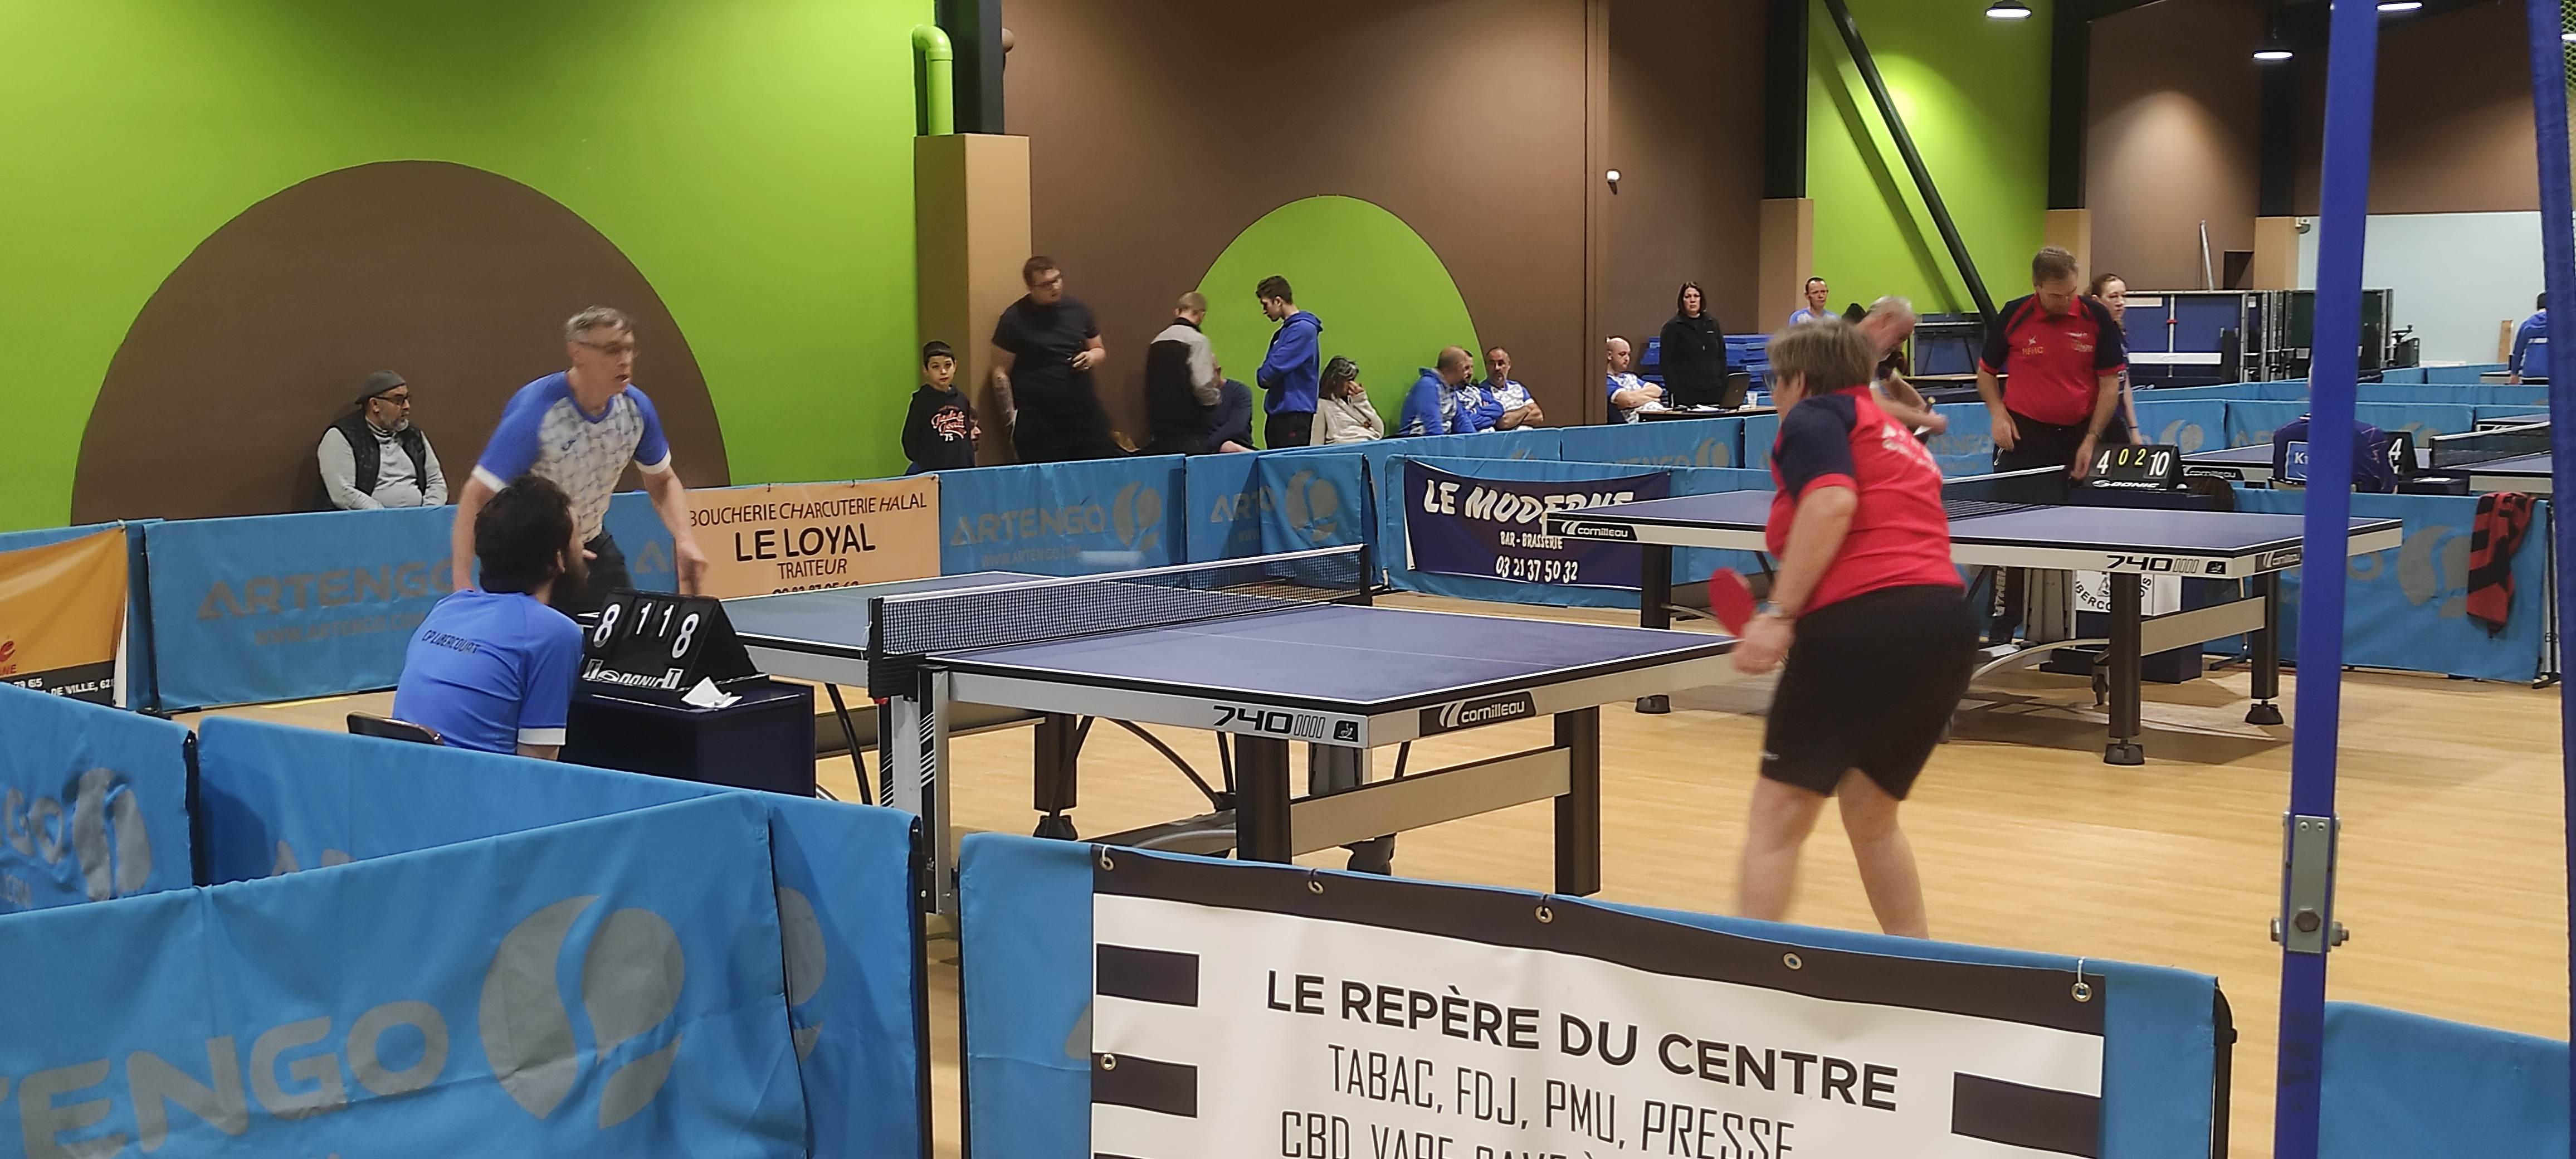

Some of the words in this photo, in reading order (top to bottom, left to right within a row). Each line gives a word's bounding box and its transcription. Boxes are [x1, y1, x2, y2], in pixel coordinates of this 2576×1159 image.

[2096, 450, 2111, 474] 4
[2119, 448, 2129, 465] 0
[2134, 448, 2146, 465] 2
[2150, 451, 2170, 476] 10
[690, 503, 777, 526] BOUCHERIE
[780, 496, 876, 519] CHARCUTERIE
[879, 492, 928, 512] HALAL
[1423, 479, 1460, 515] LE
[735, 529, 777, 562] LE
[783, 522, 876, 557] LOYAL
[950, 504, 1106, 546] ARTENGO
[1499, 531, 1515, 547] BAR
[1521, 533, 1563, 549] BRASSERIE
[1577, 525, 1628, 537] cornilleau
[777, 558, 847, 580] TRAITEUR
[1495, 556, 1510, 578] 03
[1513, 560, 1525, 576] 21
[1527, 560, 1541, 581] 37
[1544, 561, 1560, 583] 50
[1562, 562, 1578, 583] 32
[2106, 554, 2173, 572] 740
[198, 558, 453, 621] ARTENGO
[1993, 566, 2007, 617] IBHAR
[593, 603, 621, 648] 8
[636, 602, 652, 635] 1
[658, 604, 674, 637] 1
[672, 613, 699, 659] 8
[1212, 705, 1294, 734] 740
[1461, 700, 1525, 724] cornilleau
[1267, 970, 1325, 1015] LE
[1341, 980, 1540, 1050] REPÈRE
[1560, 1012, 1638, 1066] DU
[1658, 1034, 1898, 1112] CENTRE
[0, 1000, 450, 1159] ENGO
[1328, 1043, 1443, 1114] TABAC,
[1457, 1066, 1528, 1130] FDJ,
[1545, 1079, 1626, 1150] PMU,
[1641, 1099, 1795, 1159] PRESSE
[1281, 1111, 1350, 1159] CBD
